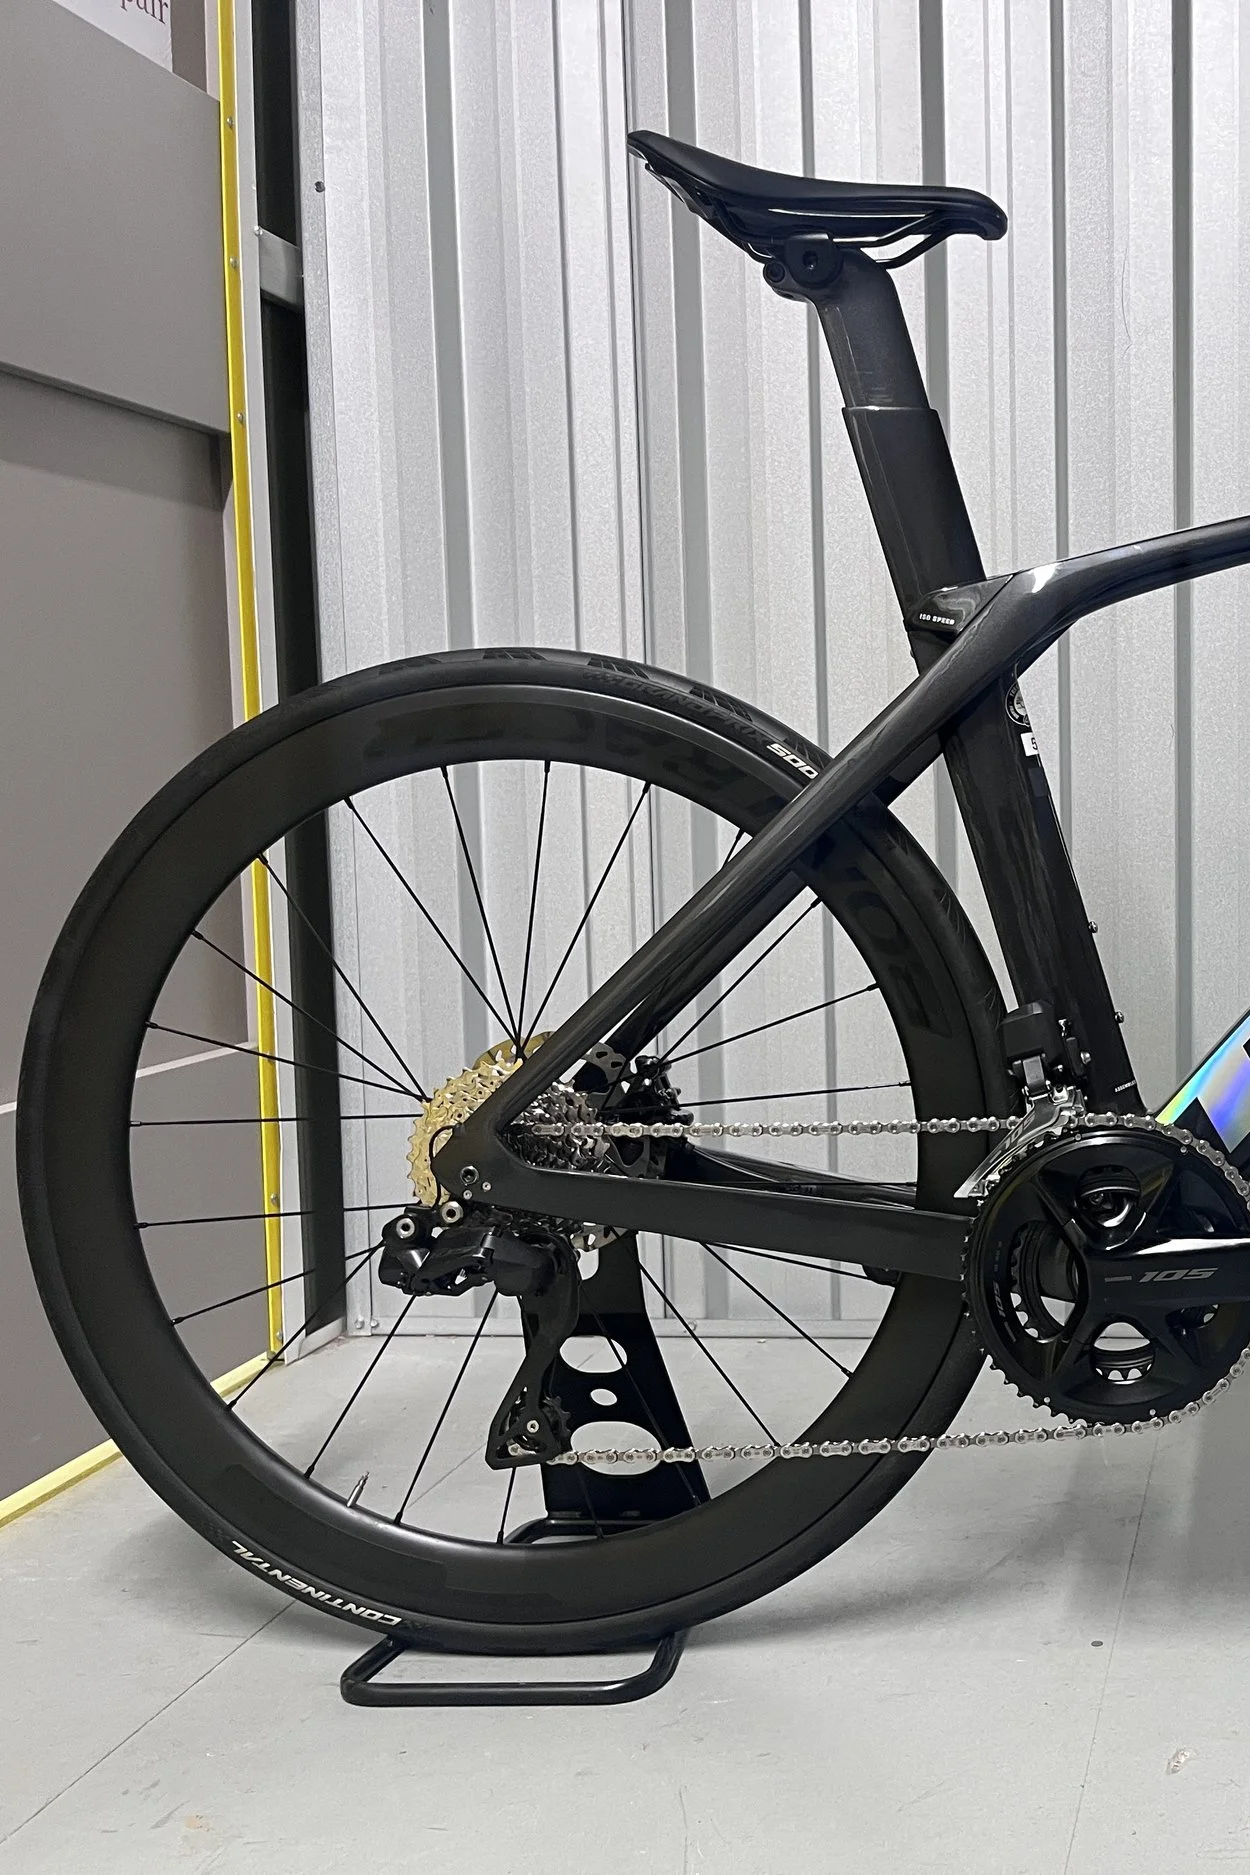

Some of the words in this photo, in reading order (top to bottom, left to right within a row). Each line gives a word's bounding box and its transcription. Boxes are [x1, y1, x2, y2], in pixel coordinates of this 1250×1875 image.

[619, 678, 705, 714] GRAND
[765, 742, 820, 780] 500
[1138, 1266, 1219, 1283] 105
[231, 1540, 404, 1627] CONTINENTAL
